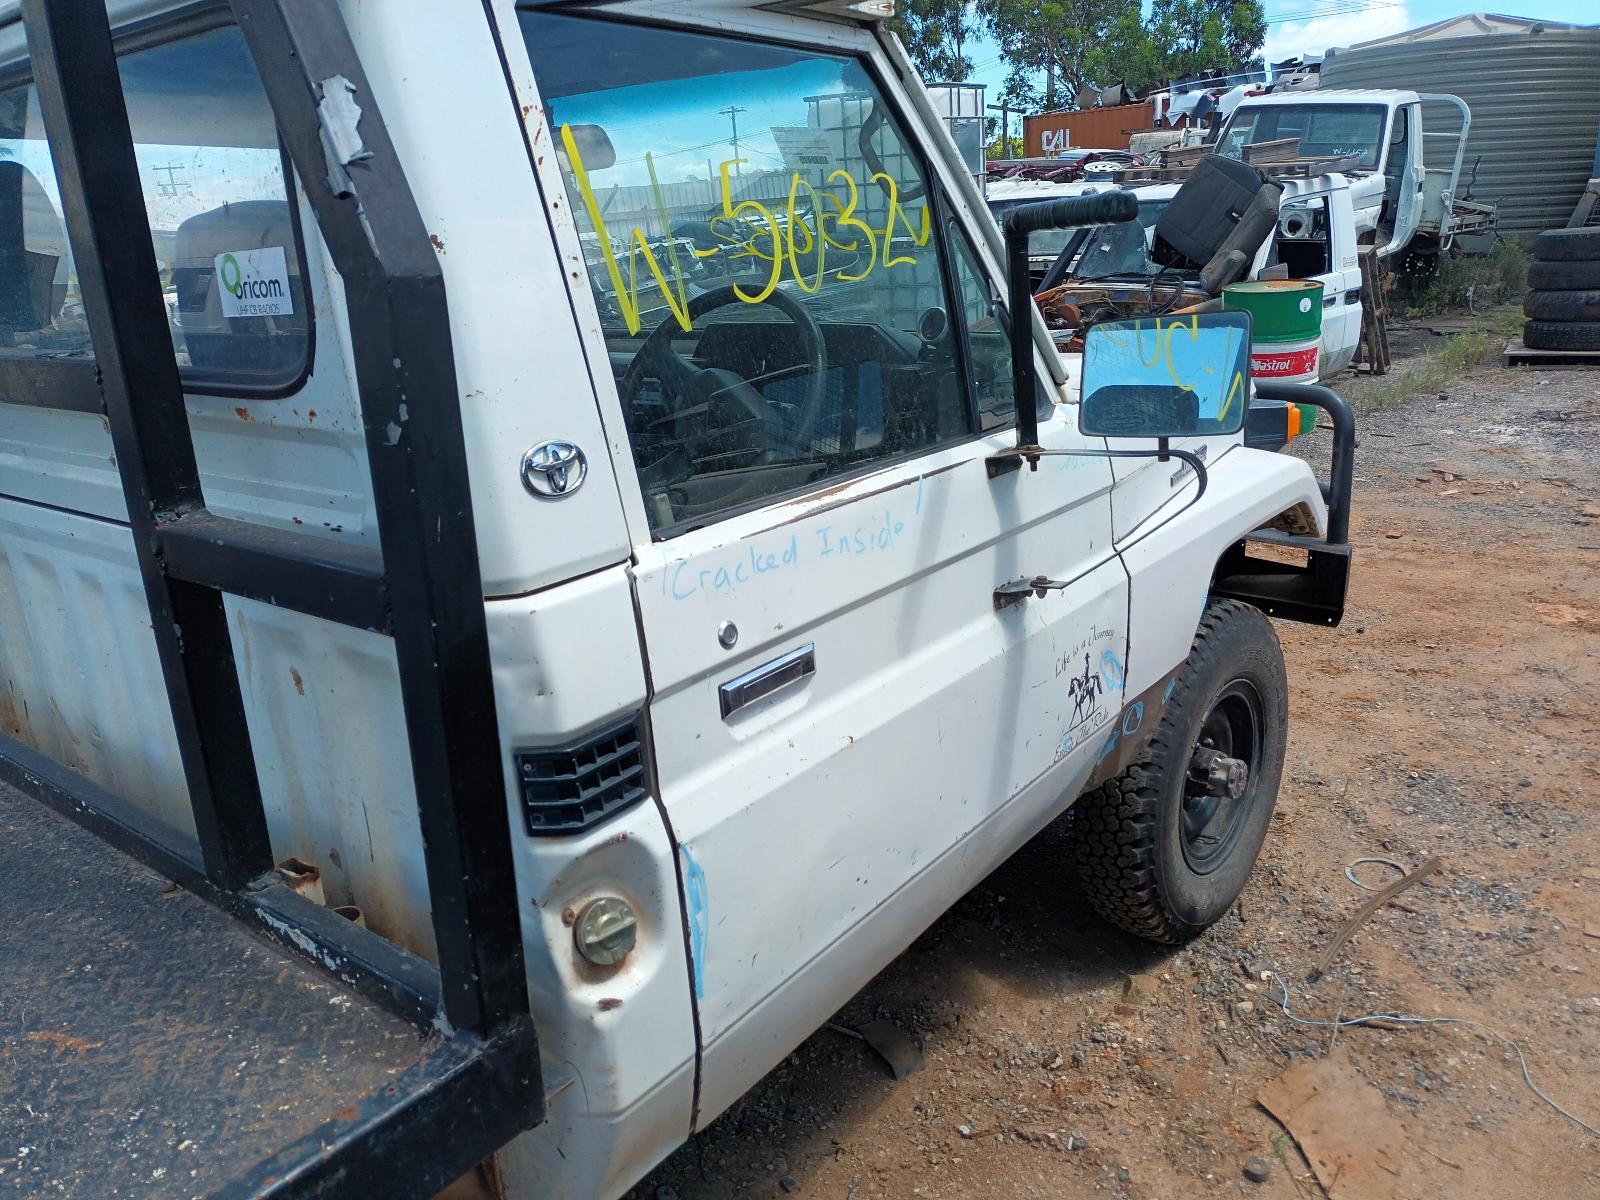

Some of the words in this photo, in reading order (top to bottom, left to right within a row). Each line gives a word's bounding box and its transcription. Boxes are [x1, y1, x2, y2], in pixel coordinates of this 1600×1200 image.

[561, 122, 917, 337] W-5032
[236, 304, 249, 315] UHF
[250, 304, 258, 315] CB
[258, 303, 281, 314] RADIOS
[672, 534, 798, 600] Cracked
[815, 512, 905, 557] Inside
[1055, 650, 1071, 678] Life
